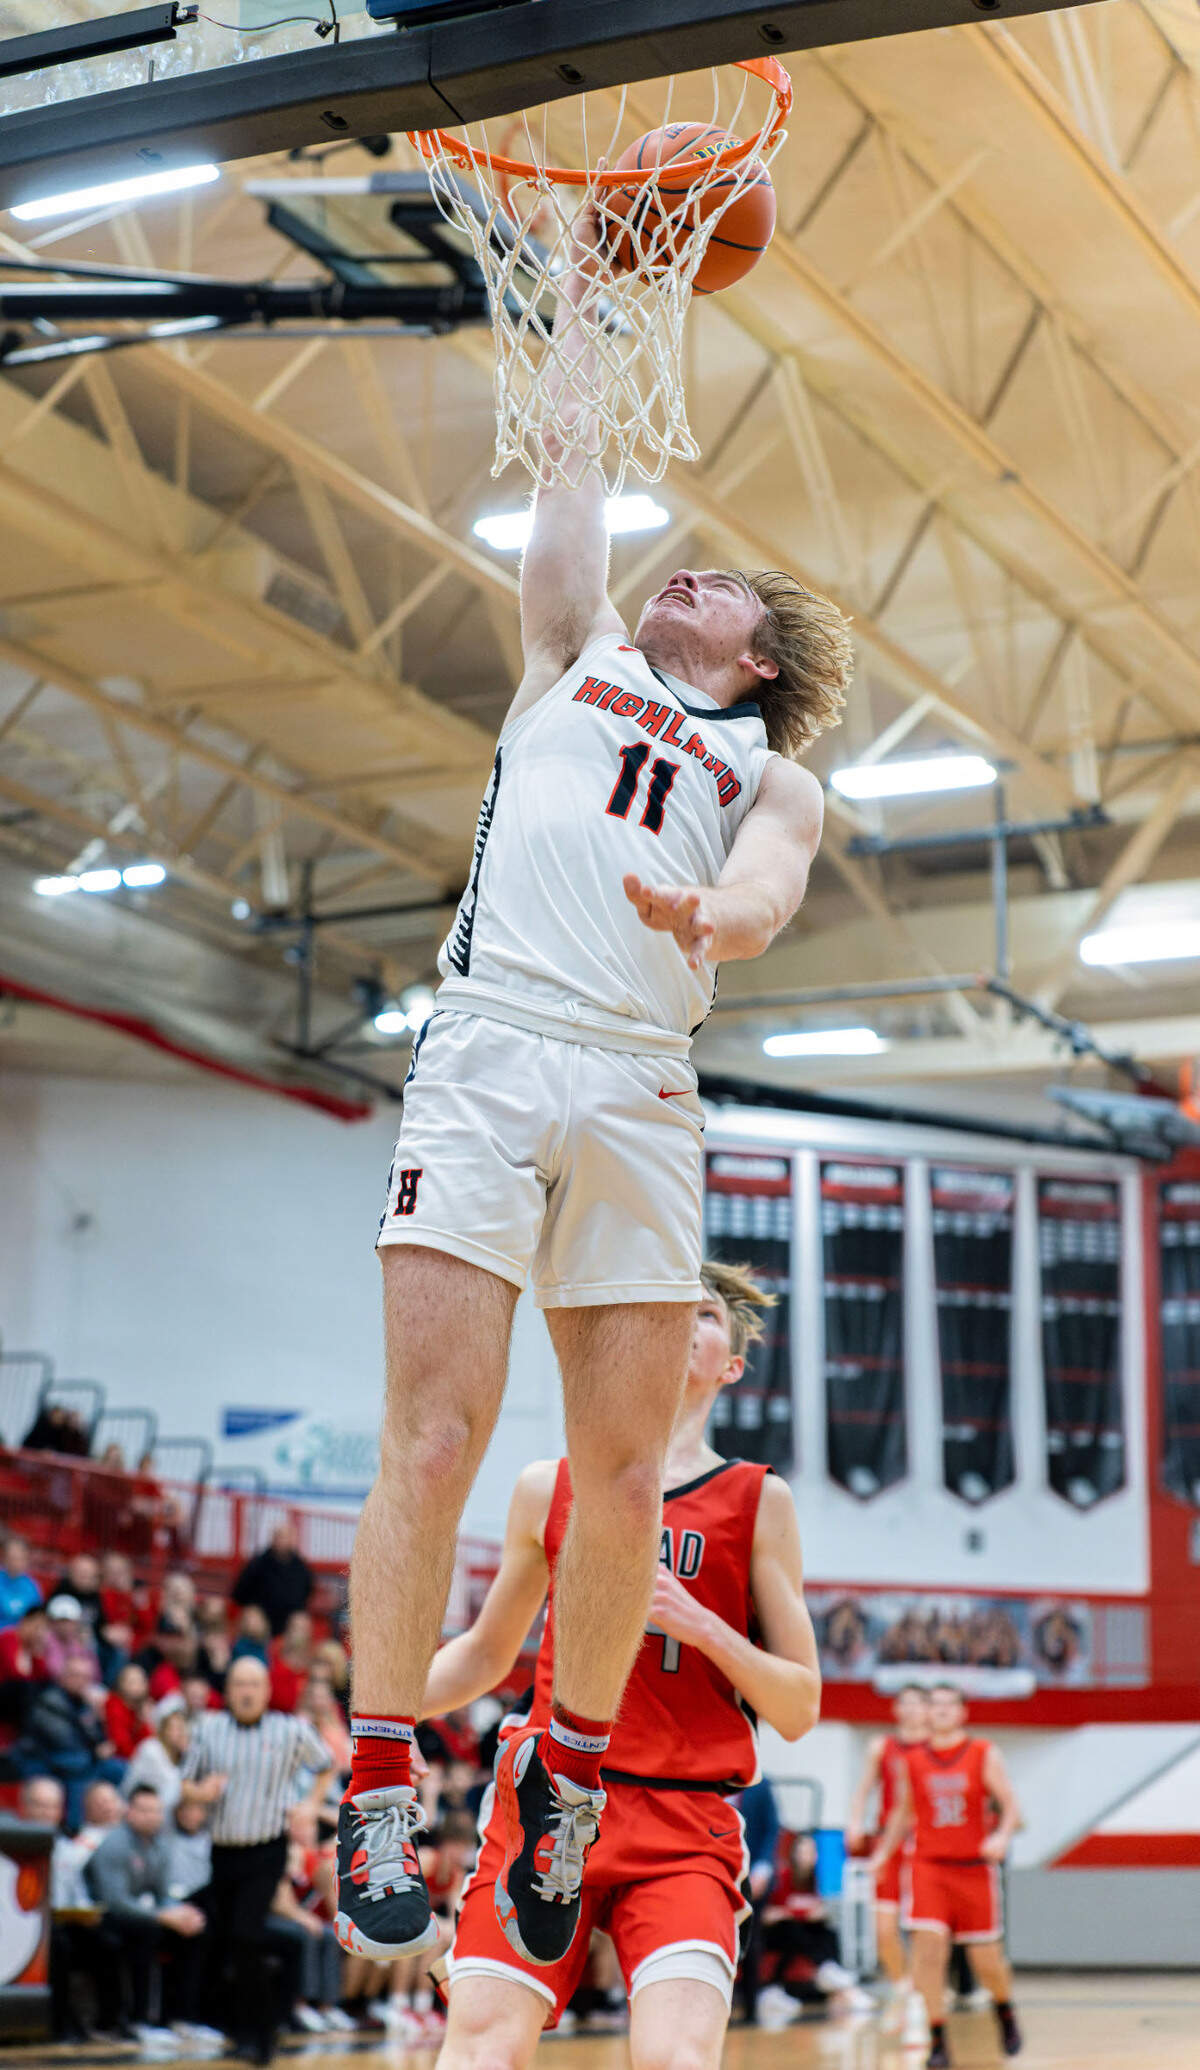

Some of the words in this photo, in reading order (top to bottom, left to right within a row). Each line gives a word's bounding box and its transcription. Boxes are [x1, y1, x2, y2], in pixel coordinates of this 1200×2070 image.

[571, 675, 742, 808] HIGHLAND
[605, 740, 682, 836] 11
[392, 1168, 424, 1216] H
